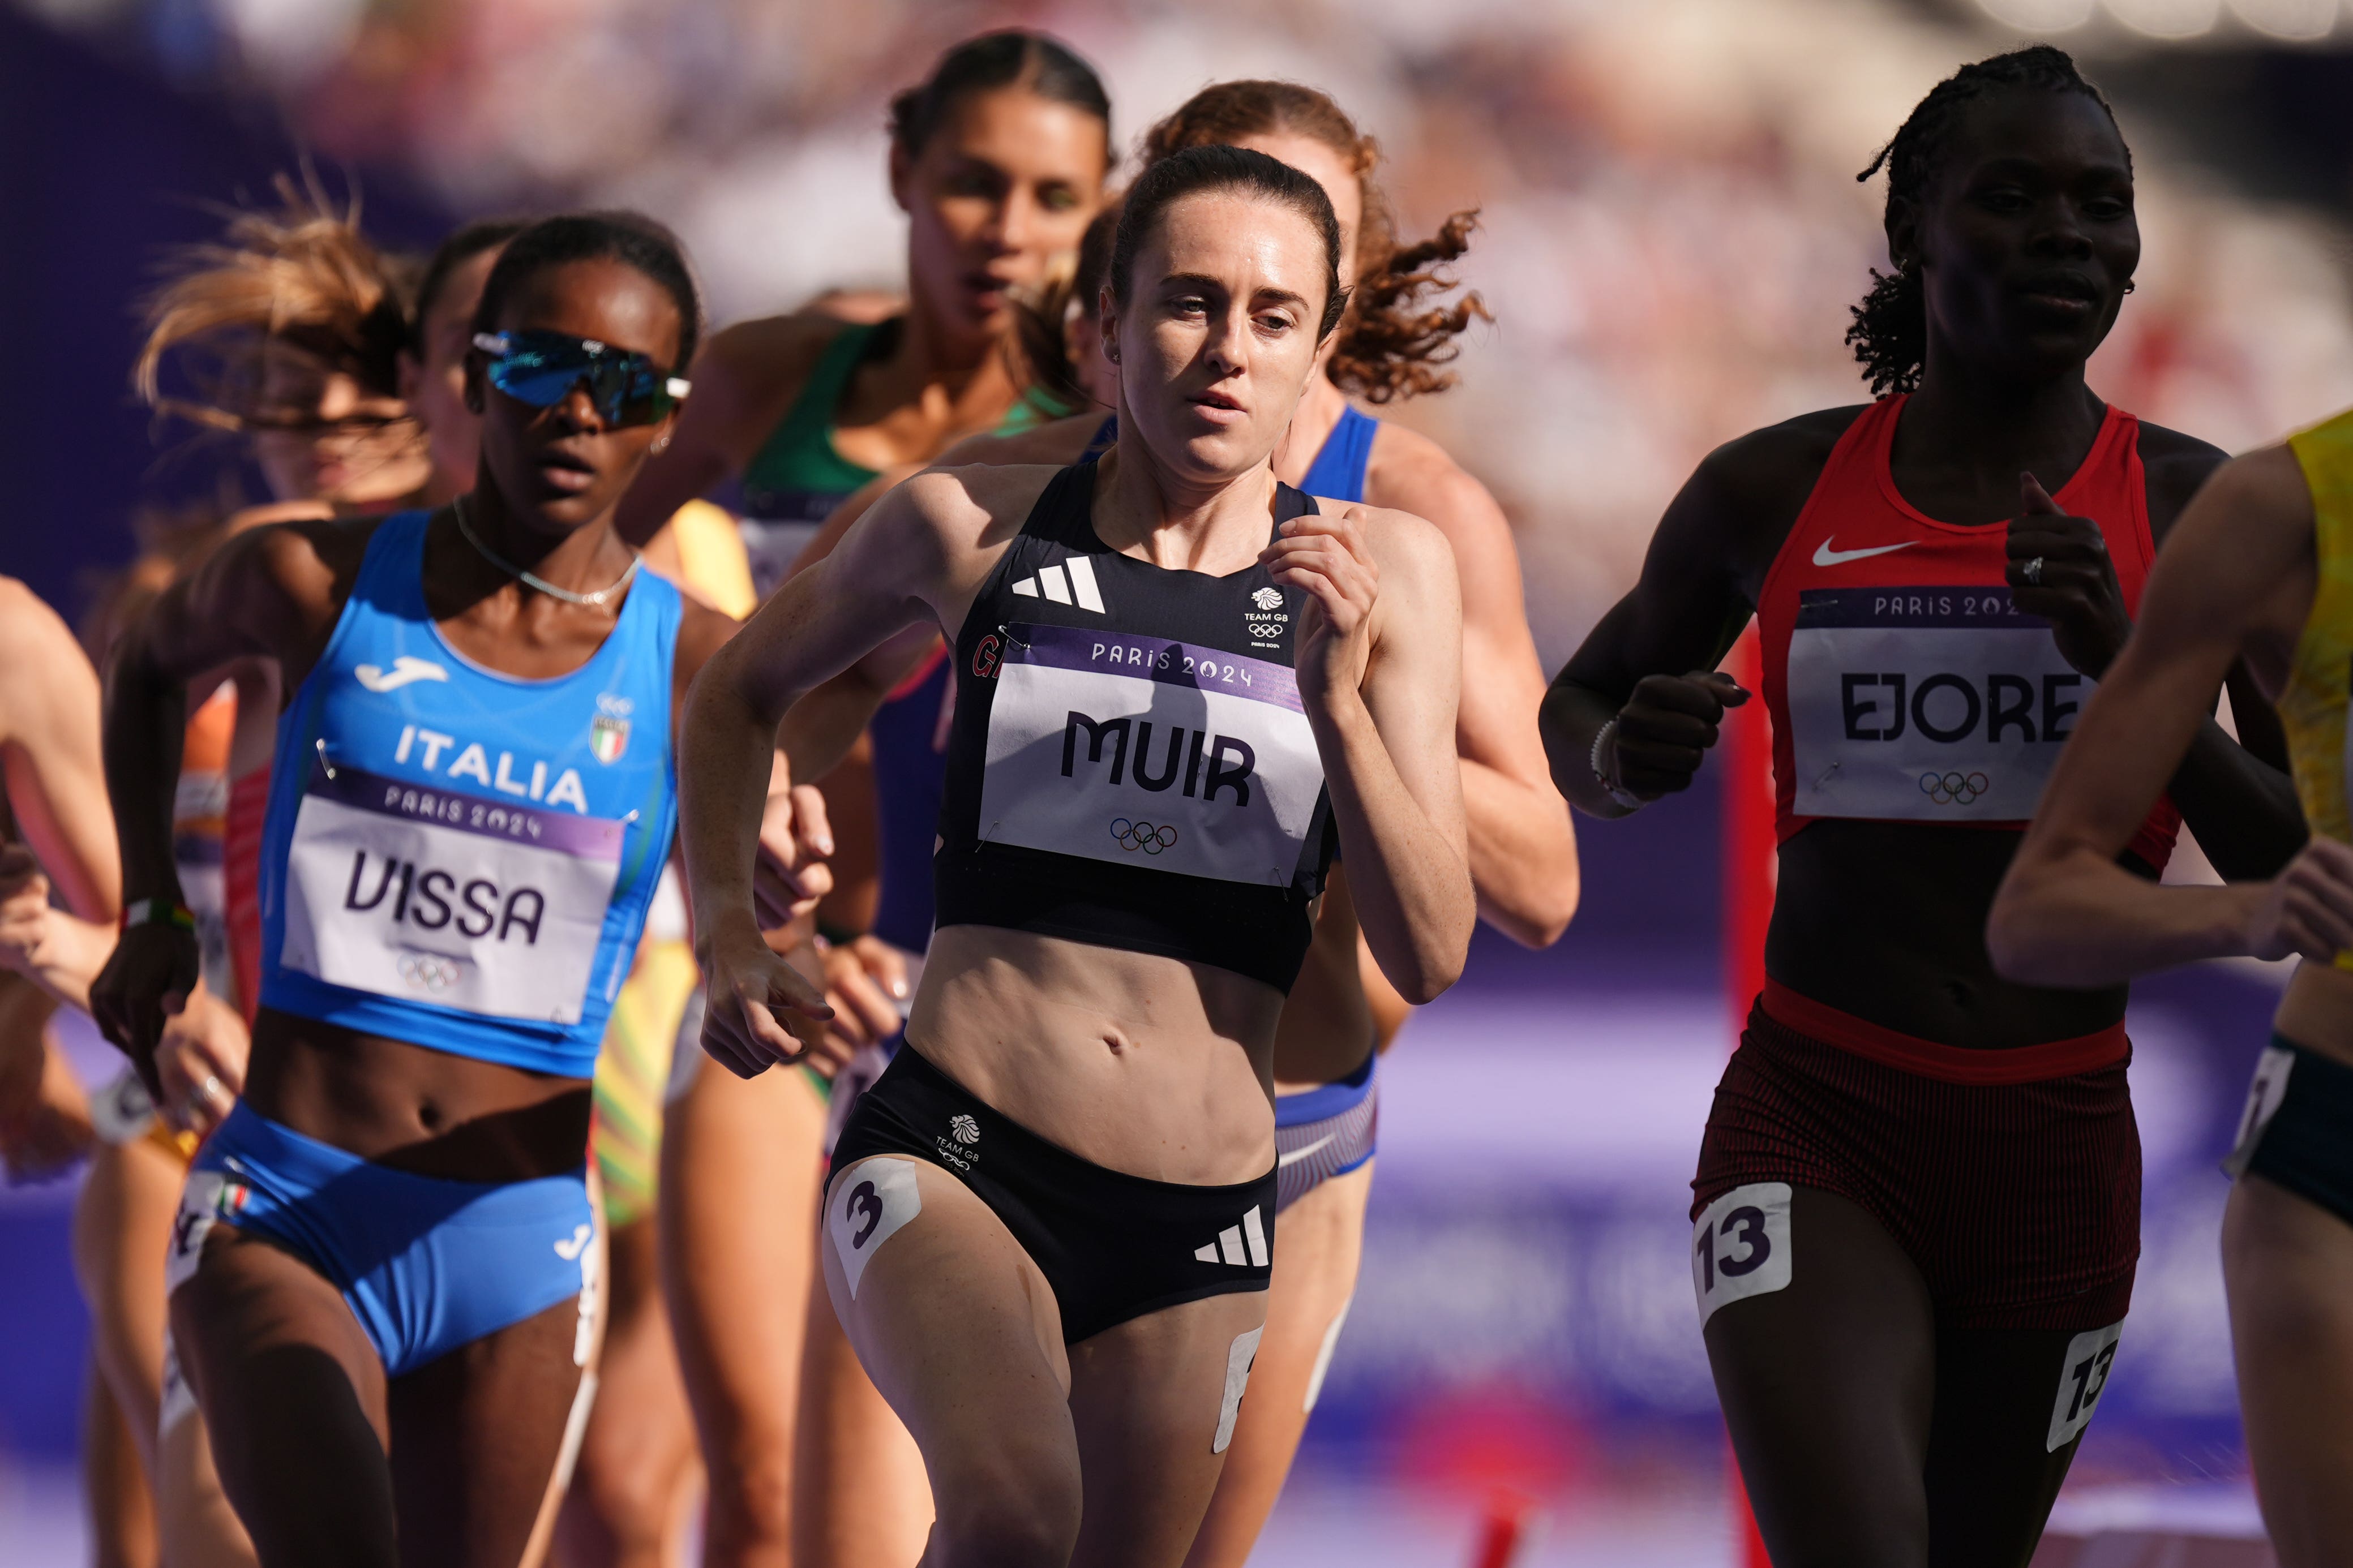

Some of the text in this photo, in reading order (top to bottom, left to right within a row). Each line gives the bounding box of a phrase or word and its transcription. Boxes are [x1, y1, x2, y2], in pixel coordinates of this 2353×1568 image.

[1274, 613, 1288, 622] GB
[1964, 596, 2020, 616] 202
[1181, 656, 1252, 687] 2024
[1841, 673, 2082, 744] EJORE
[394, 724, 588, 815] ITALIA
[1060, 710, 1256, 807] MUIR
[470, 804, 542, 840] 2024
[344, 850, 545, 946] VISSA
[936, 1136, 979, 1162] TEAM GB
[846, 1180, 883, 1250] 3
[1697, 1206, 1771, 1295] 13
[2065, 1339, 2119, 1423] 13
